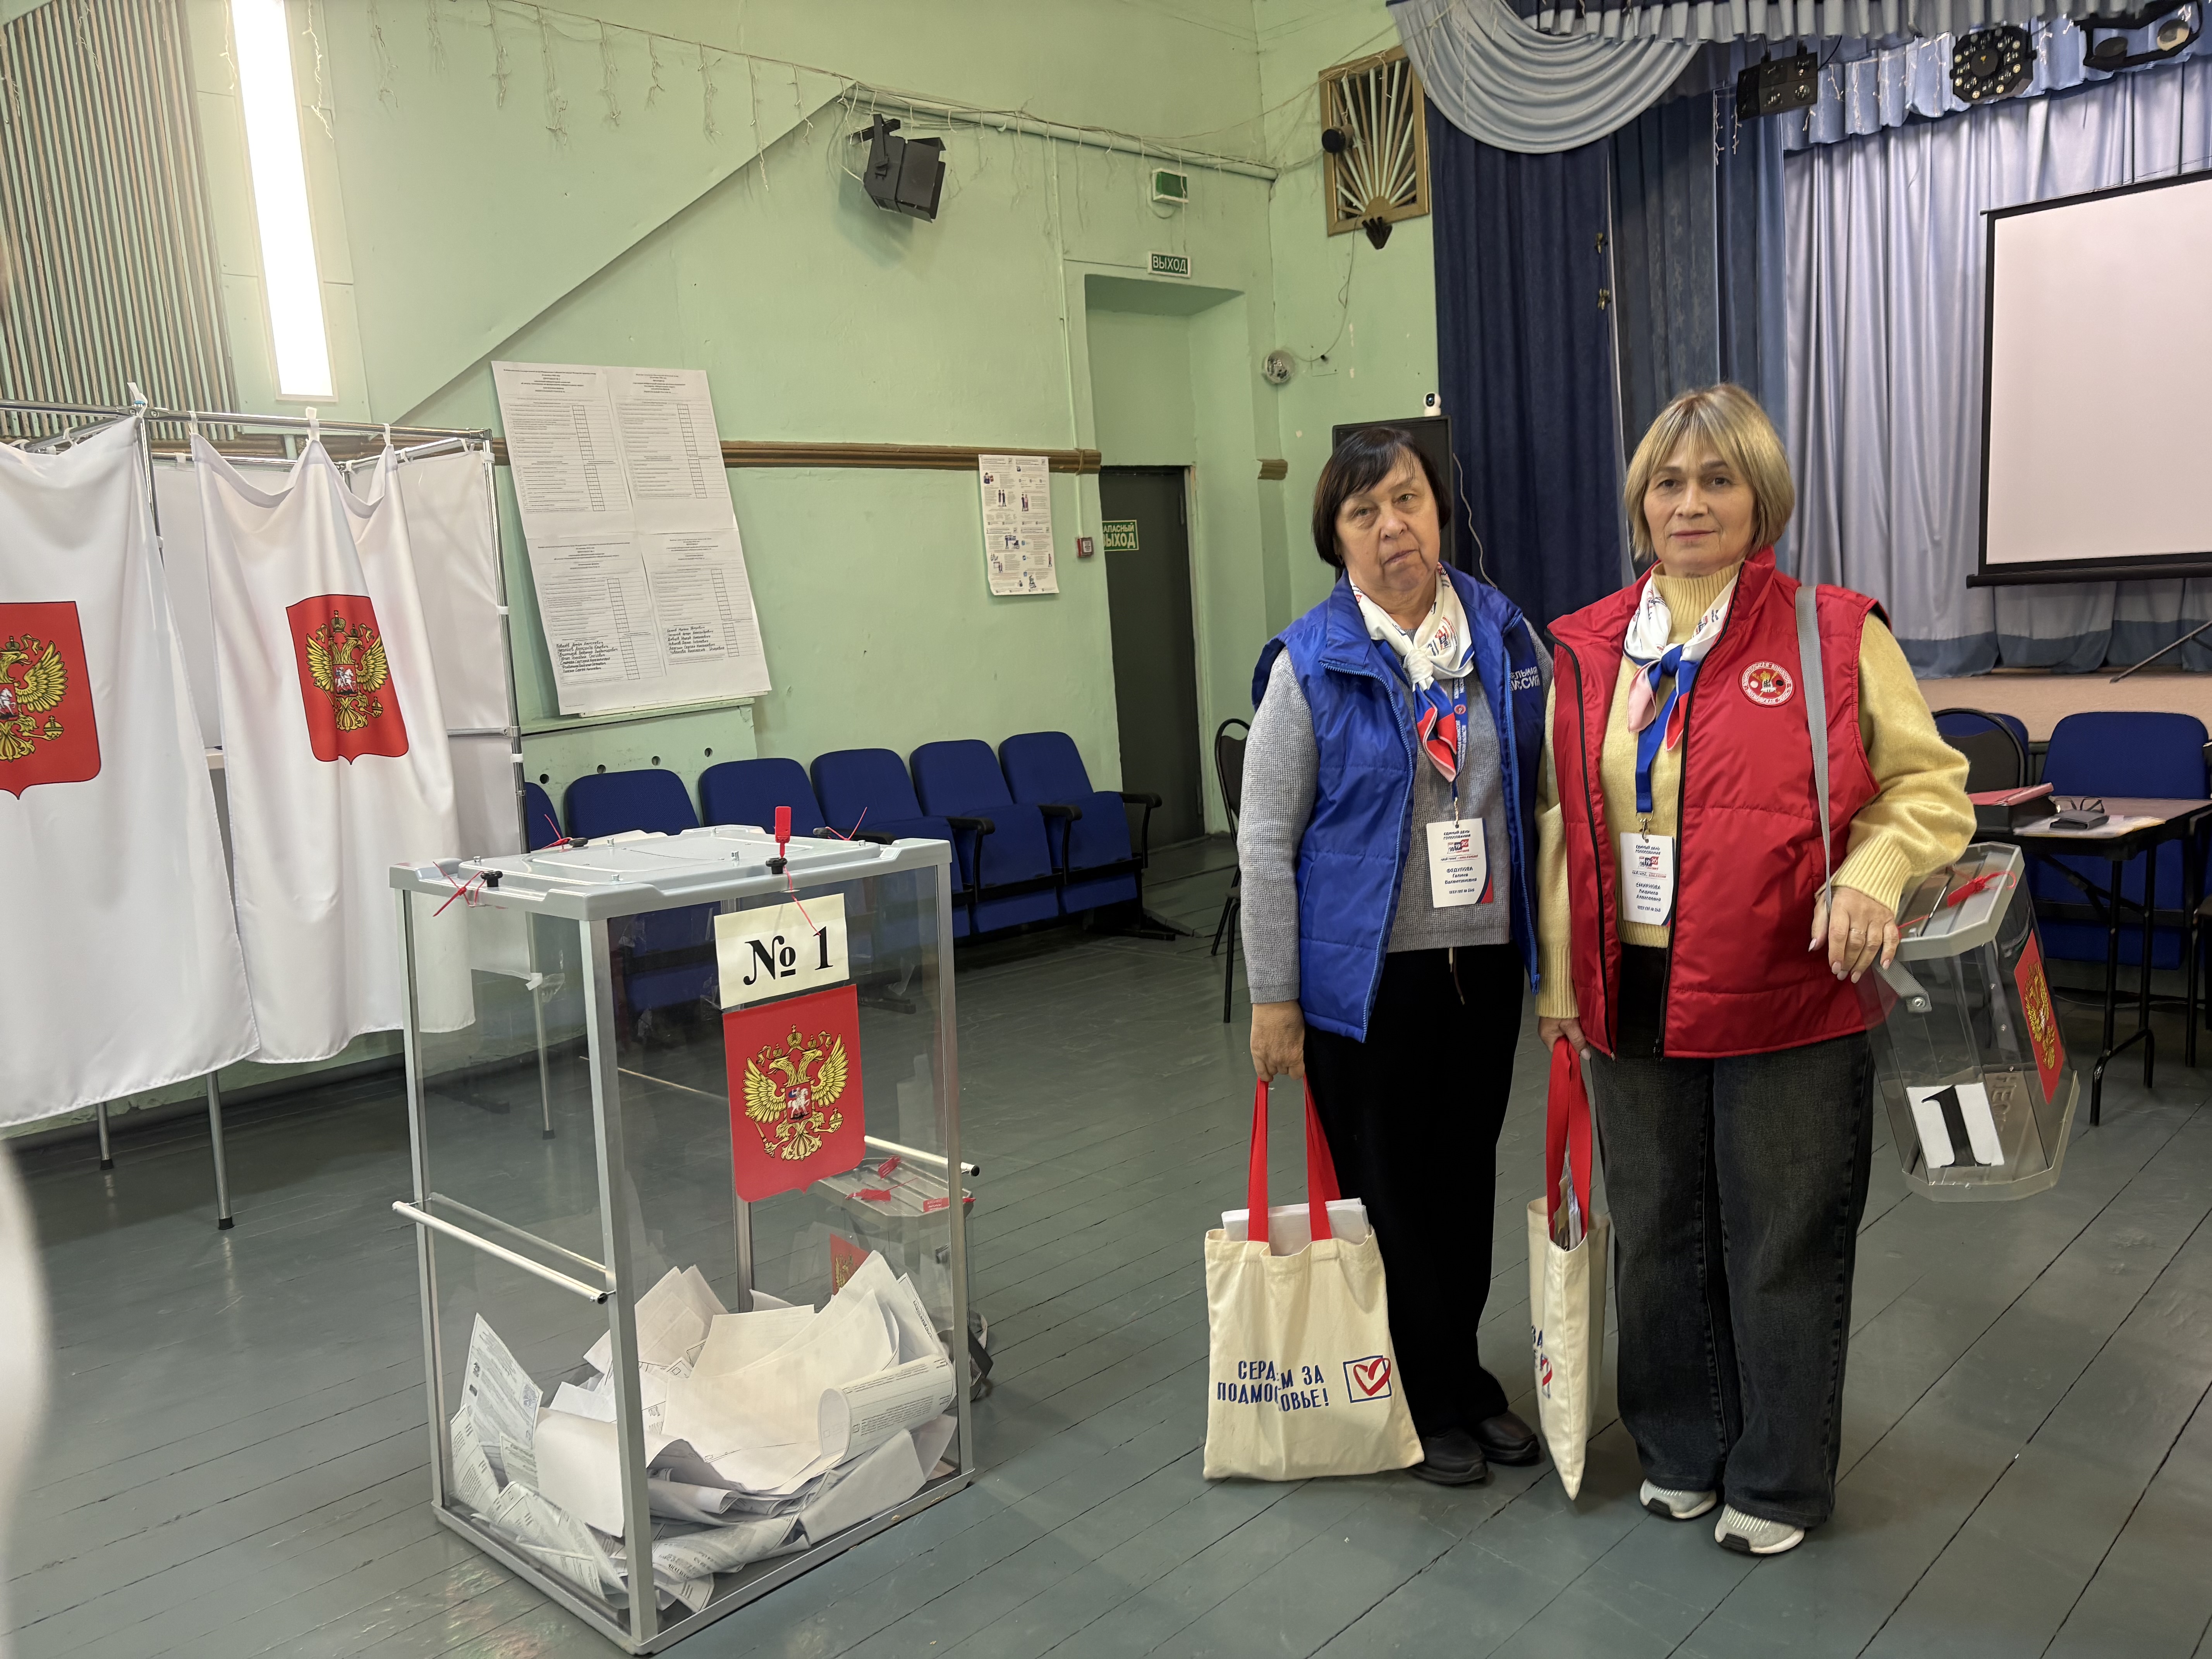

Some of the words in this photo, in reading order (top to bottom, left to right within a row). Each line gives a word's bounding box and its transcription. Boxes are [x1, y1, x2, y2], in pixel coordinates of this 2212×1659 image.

[1153, 256, 1187, 273] ВЫХОД
[1104, 522, 1134, 532] АПАСНЫЙ
[743, 936, 796, 986] №
[813, 926, 833, 970] 1
[1921, 1085, 1992, 1168] 1
[1238, 1360, 1294, 1390] СЕРДМ
[1302, 1365, 1324, 1386] ЗА
[1217, 1382, 1329, 1412] ПОДМООВЬЕ!
